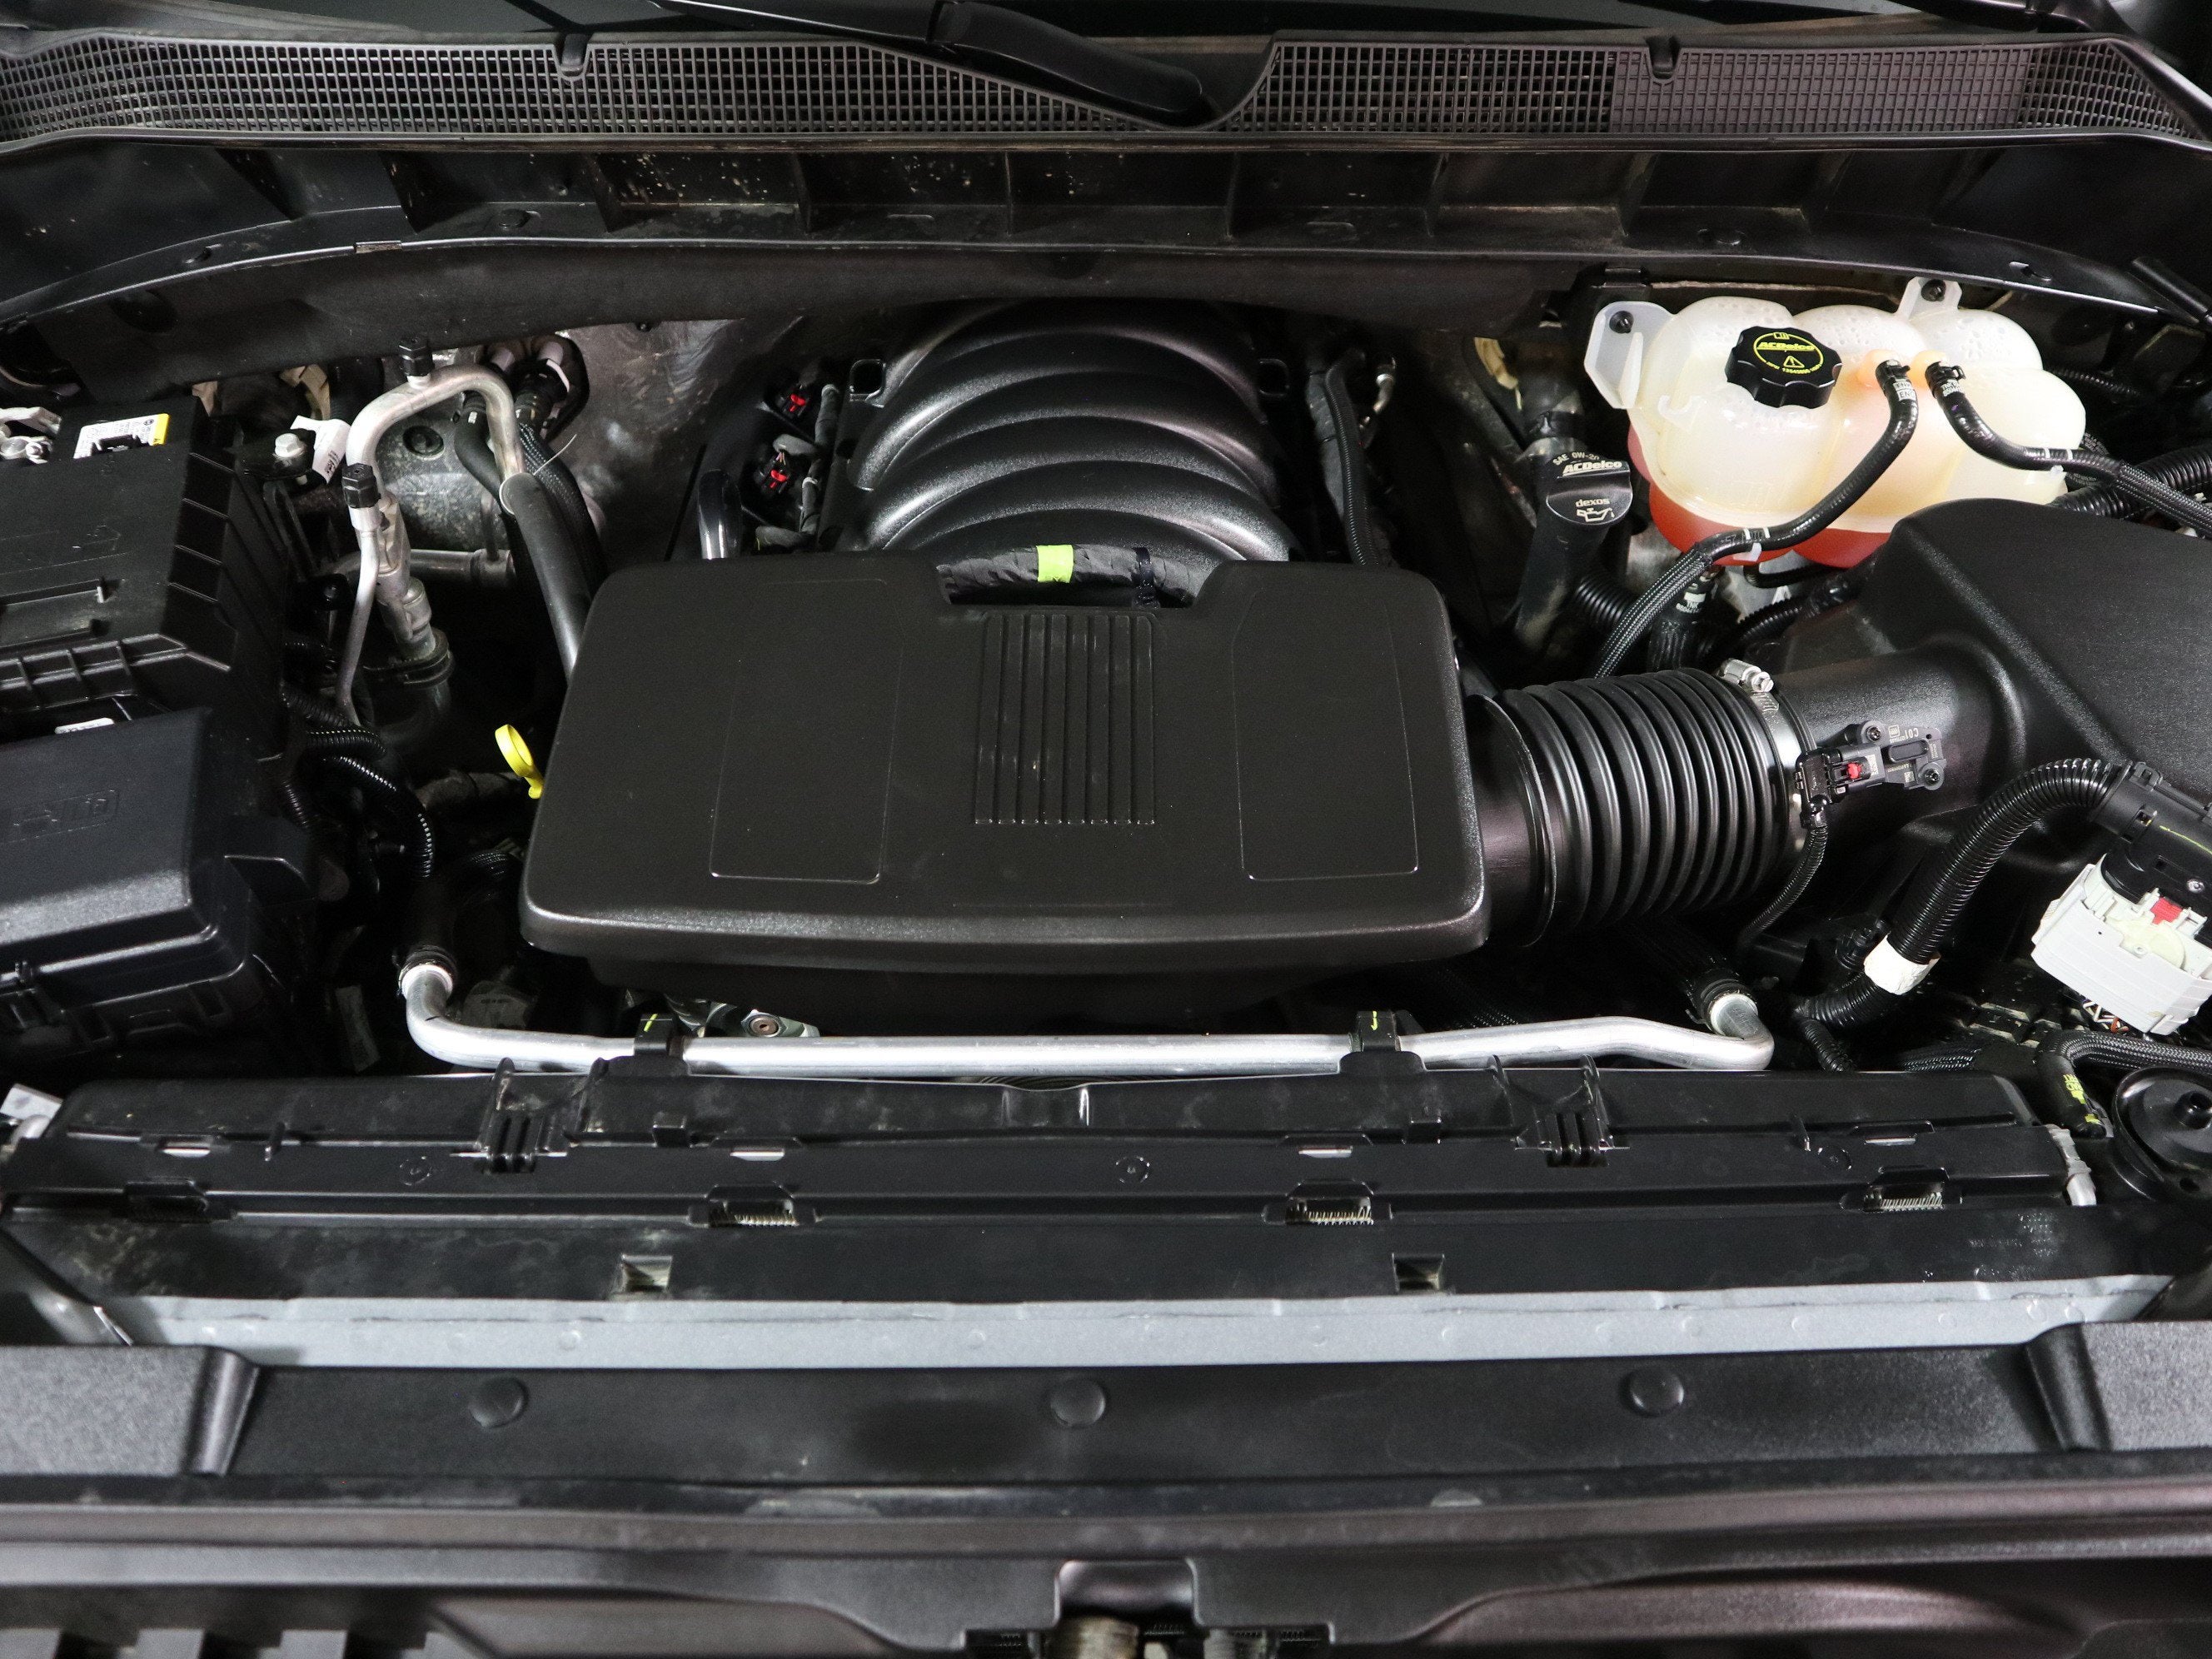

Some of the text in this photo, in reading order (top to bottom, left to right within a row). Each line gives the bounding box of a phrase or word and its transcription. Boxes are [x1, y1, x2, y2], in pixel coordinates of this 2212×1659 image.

[1552, 454, 1569, 466] SAE
[1562, 460, 1622, 477] ACDelco
[1575, 498, 1610, 507] dexos
